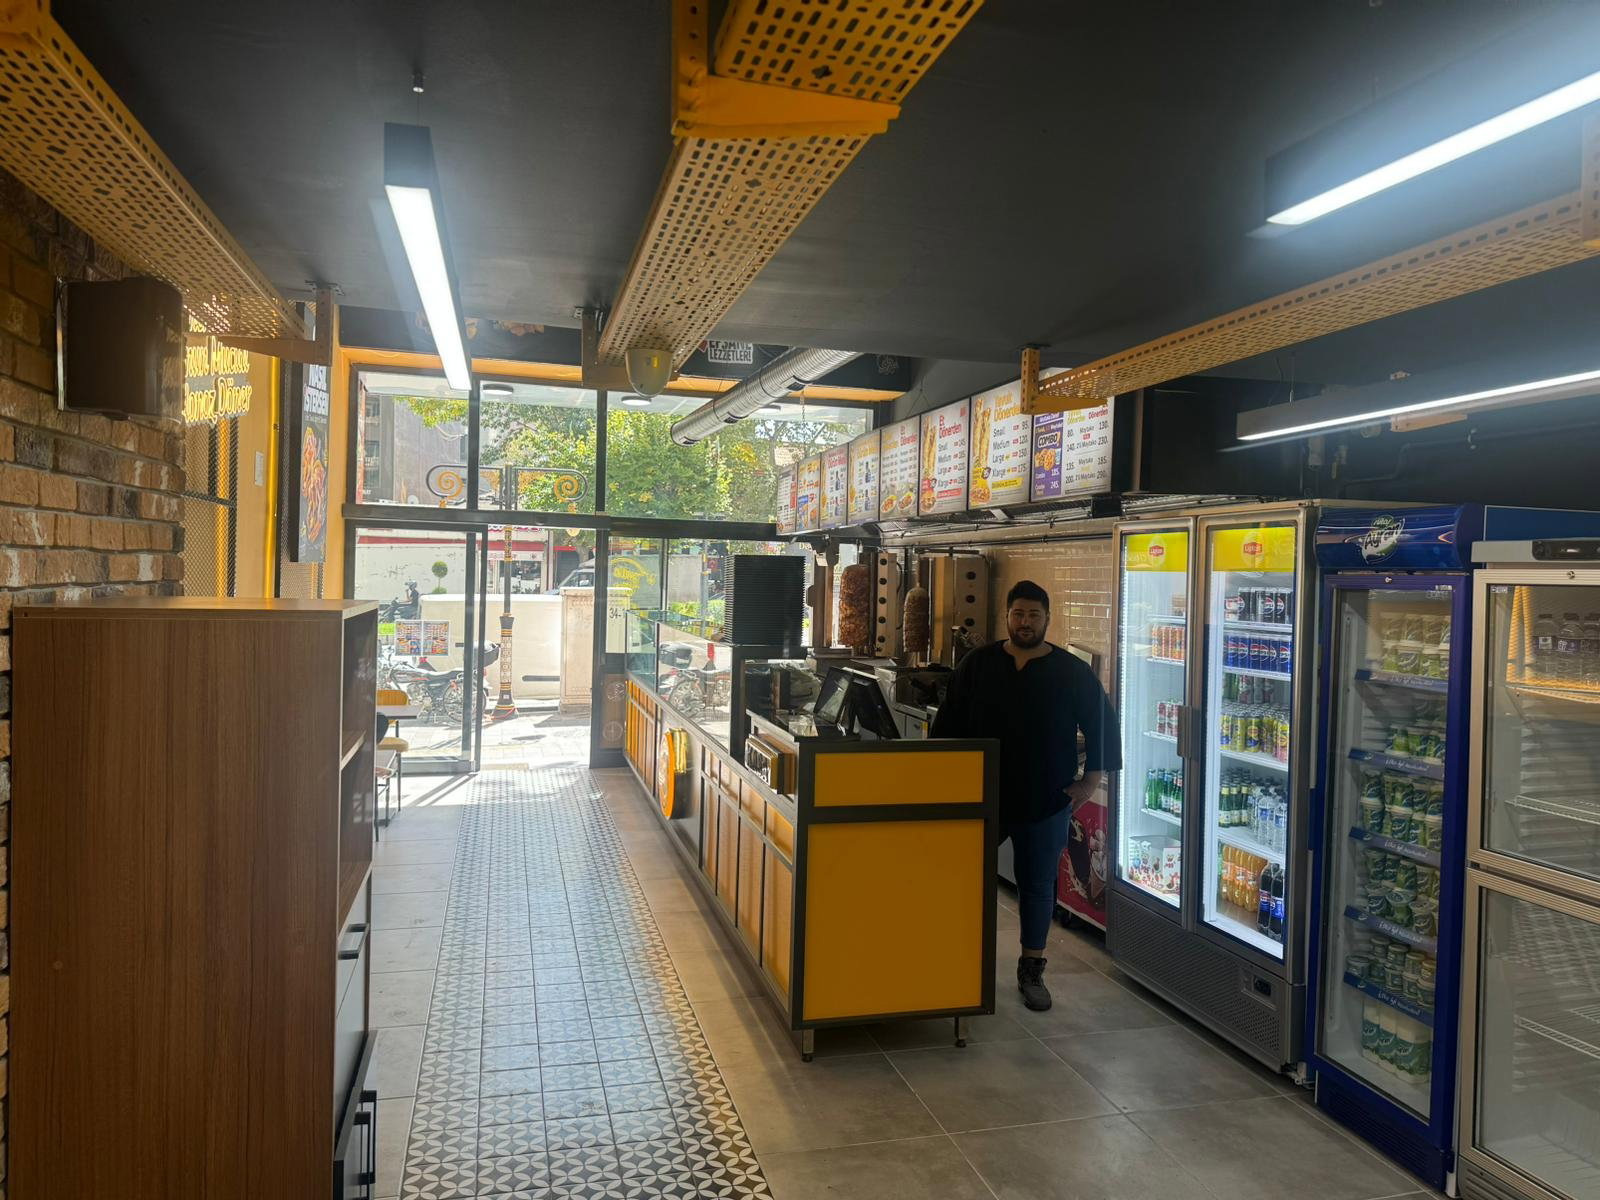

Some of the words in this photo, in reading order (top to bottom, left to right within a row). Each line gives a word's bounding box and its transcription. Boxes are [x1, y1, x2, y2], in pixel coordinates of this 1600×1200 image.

[710, 348, 751, 362] LEZZETLER!
[218, 377, 252, 416] Döner
[1039, 432, 1058, 447] COMBO
